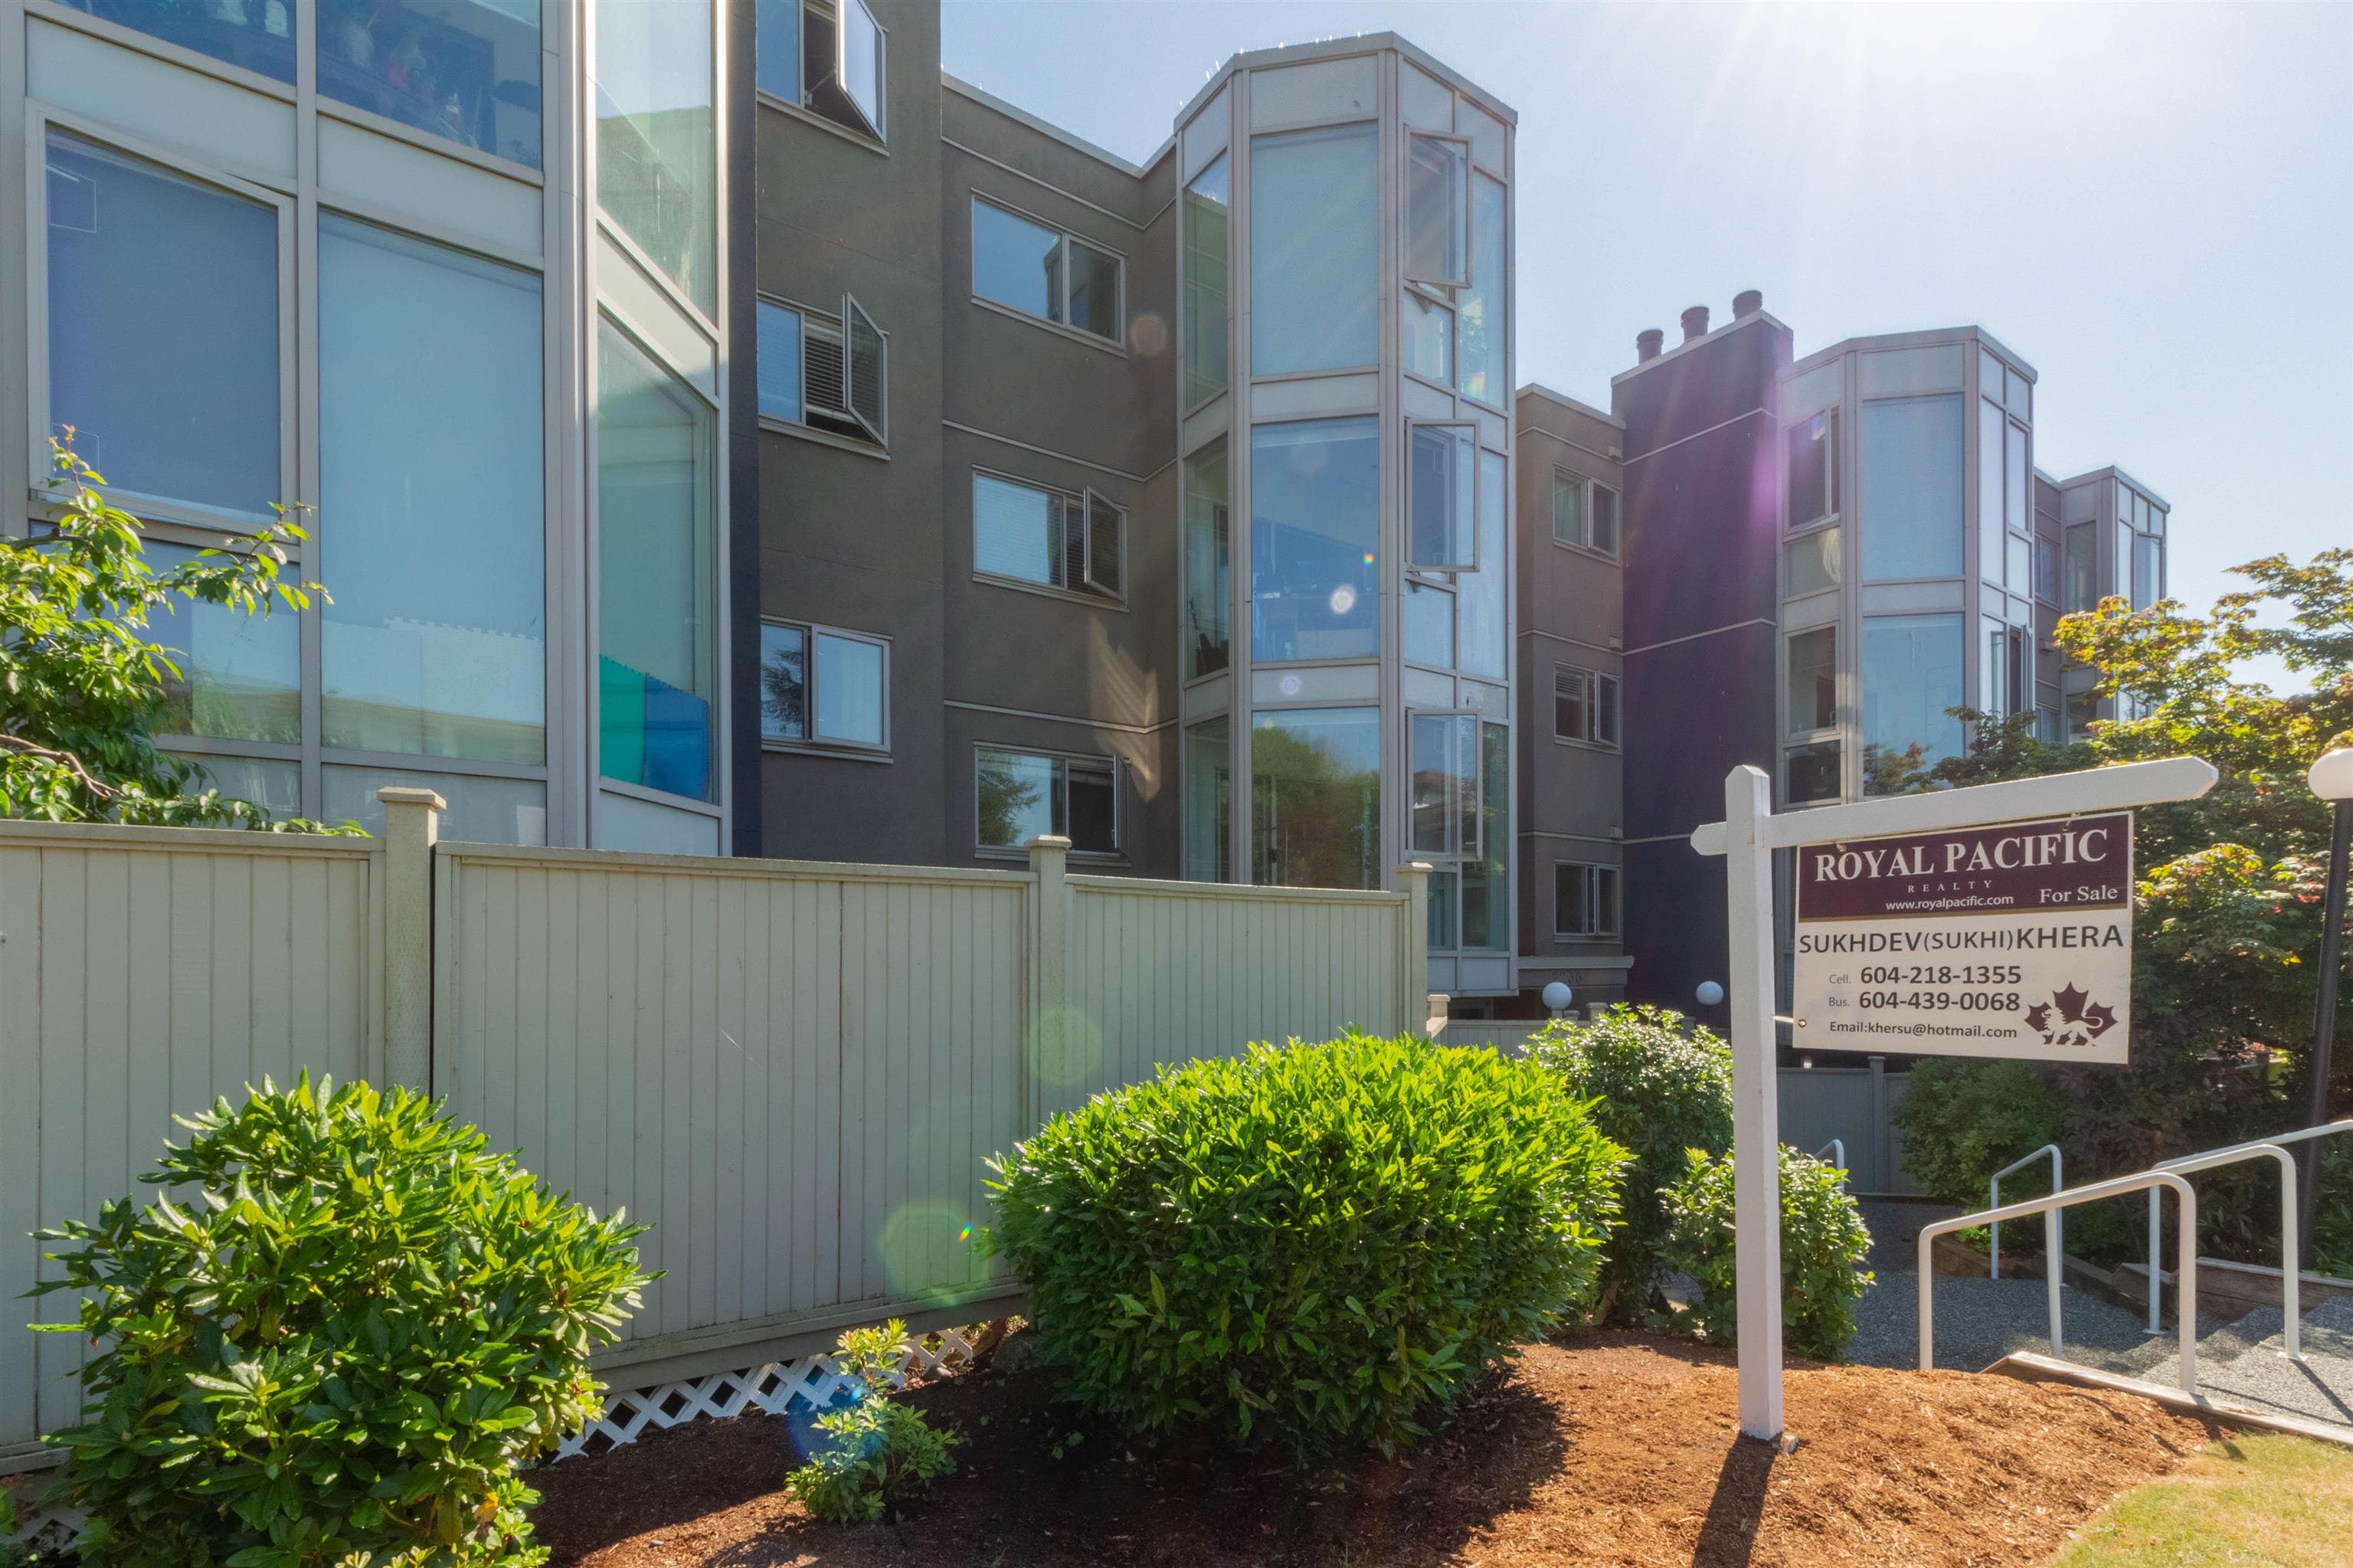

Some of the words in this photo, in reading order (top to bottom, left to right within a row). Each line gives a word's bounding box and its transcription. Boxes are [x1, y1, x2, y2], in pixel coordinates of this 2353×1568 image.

[1815, 846, 1934, 882] ROYAL
[1945, 829, 2108, 872] PACIFIC
[1907, 880, 1992, 893] REALTY
[2039, 888, 2071, 904] For
[2076, 885, 2118, 902] Sale
[1886, 894, 2014, 912] www.royalpacific.com
[1828, 974, 1851, 985] Cell.
[1860, 965, 2021, 985] 604-218-1355
[1828, 997, 1850, 1007] Bus.
[1859, 992, 2021, 1011] 604-439-0068
[1829, 1021, 2018, 1039] Email:khersu@hotmail.com
